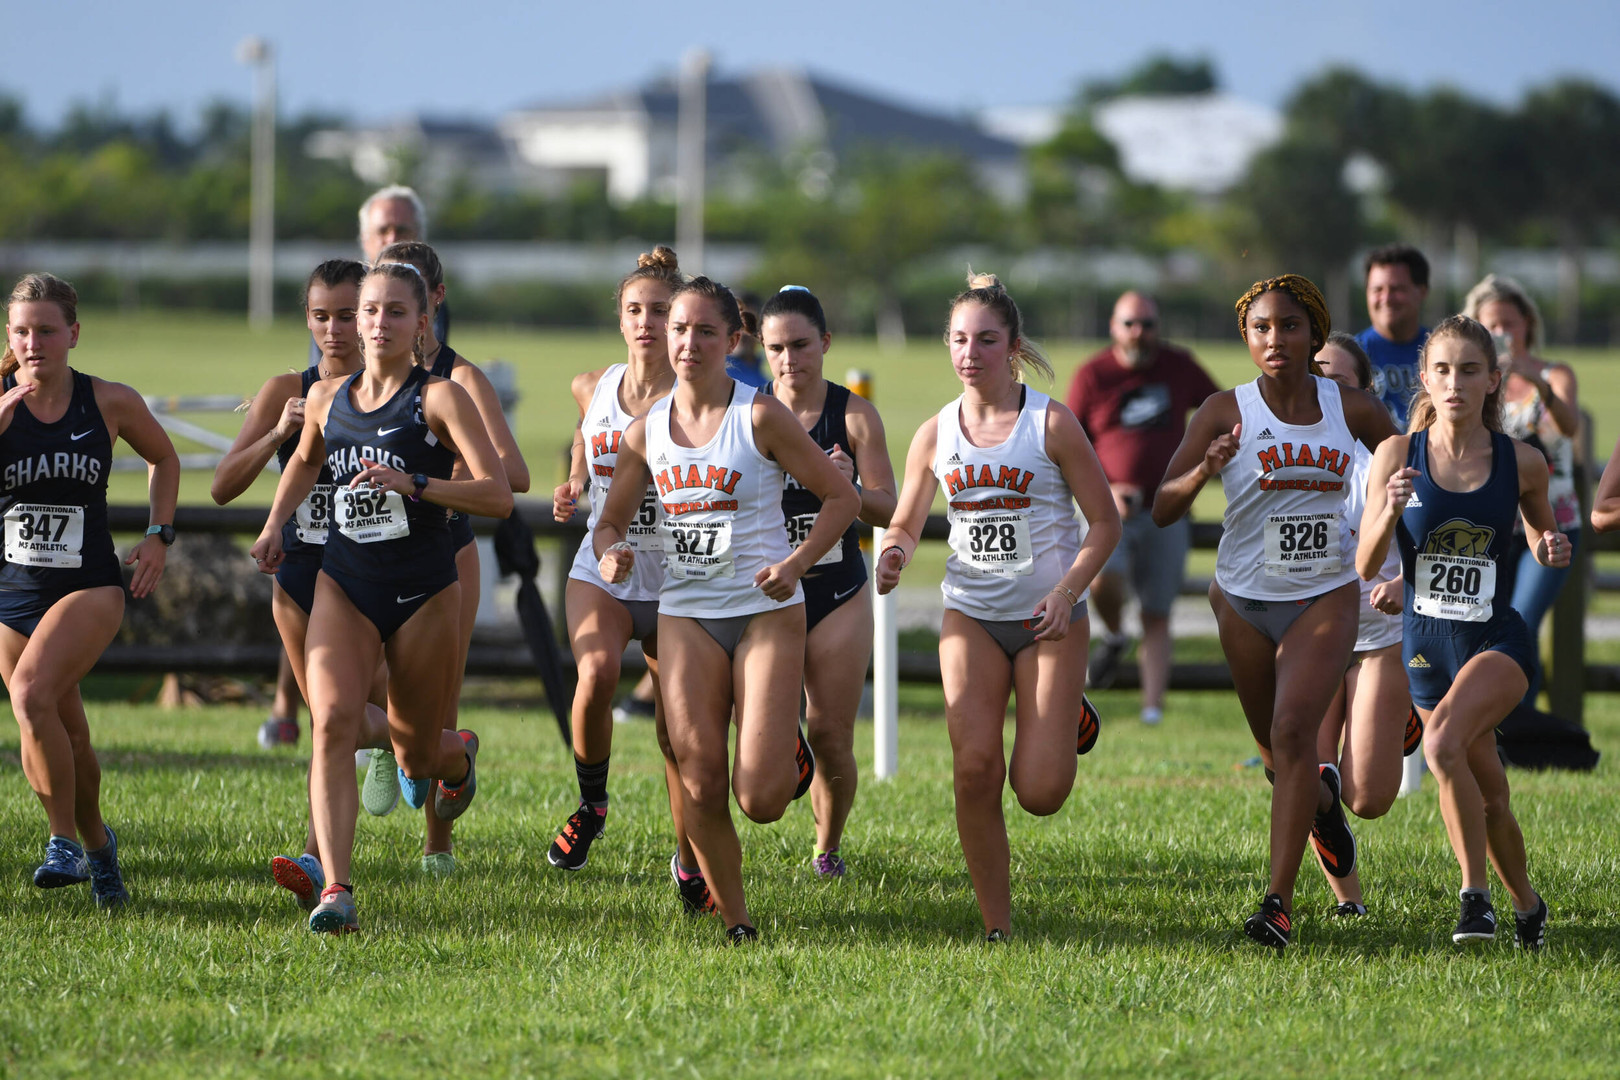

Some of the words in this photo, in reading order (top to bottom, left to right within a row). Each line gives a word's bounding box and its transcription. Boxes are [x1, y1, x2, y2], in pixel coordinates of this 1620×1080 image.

[4, 452, 101, 490] SHARKS
[1257, 442, 1350, 477] MIAMI
[656, 464, 742, 498] MIAMI
[944, 464, 1034, 496] MIAMI
[344, 490, 391, 520] 352
[1287, 514, 1334, 522] INVITATIONAL
[18, 513, 70, 542] 347
[356, 516, 392, 528] ATHLETIC
[784, 516, 814, 543] 35
[973, 516, 1022, 524] INVITATIONAL
[30, 543, 68, 552] ATHLETIC
[672, 529, 718, 556] 327
[968, 524, 1016, 553] 328
[1280, 522, 1328, 552] 326
[687, 556, 720, 564] ATHLETIC
[982, 552, 1018, 562] ATHLETIC
[1294, 551, 1328, 560] ATHLETIC
[1440, 556, 1490, 568] INVITATIONAL
[1430, 564, 1481, 596] 260
[1441, 594, 1480, 604] ATHLETIC
